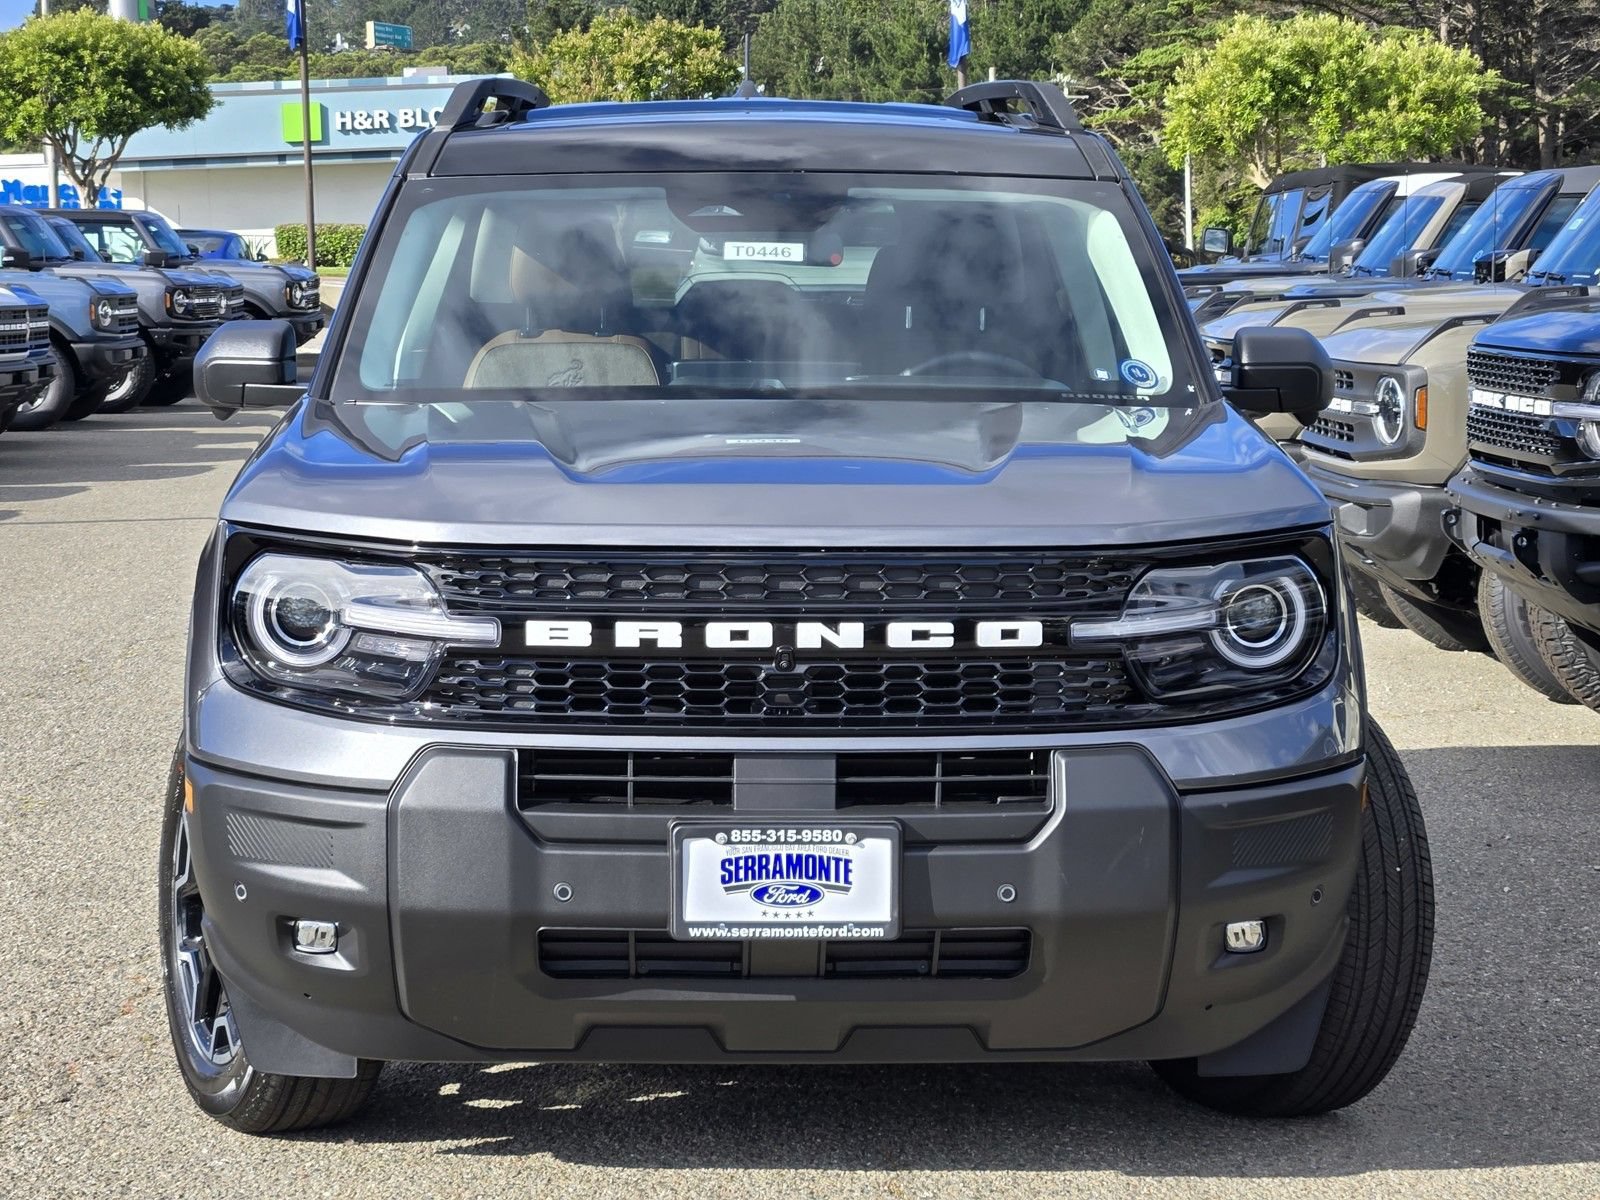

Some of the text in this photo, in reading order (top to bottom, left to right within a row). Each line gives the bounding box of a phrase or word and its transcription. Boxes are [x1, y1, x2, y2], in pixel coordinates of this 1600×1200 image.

[335, 106, 444, 131] H&R BLO
[733, 245, 792, 258] T0446
[525, 619, 1043, 649] BRONCO
[730, 829, 843, 843] 855-315-9580
[742, 845, 753, 854] SAN
[812, 845, 828, 854] FORD
[828, 846, 850, 857] DEALER
[720, 853, 853, 886] SERRAMONTE
[763, 884, 811, 905] Ford
[688, 924, 884, 938] www.serramonteford.com
